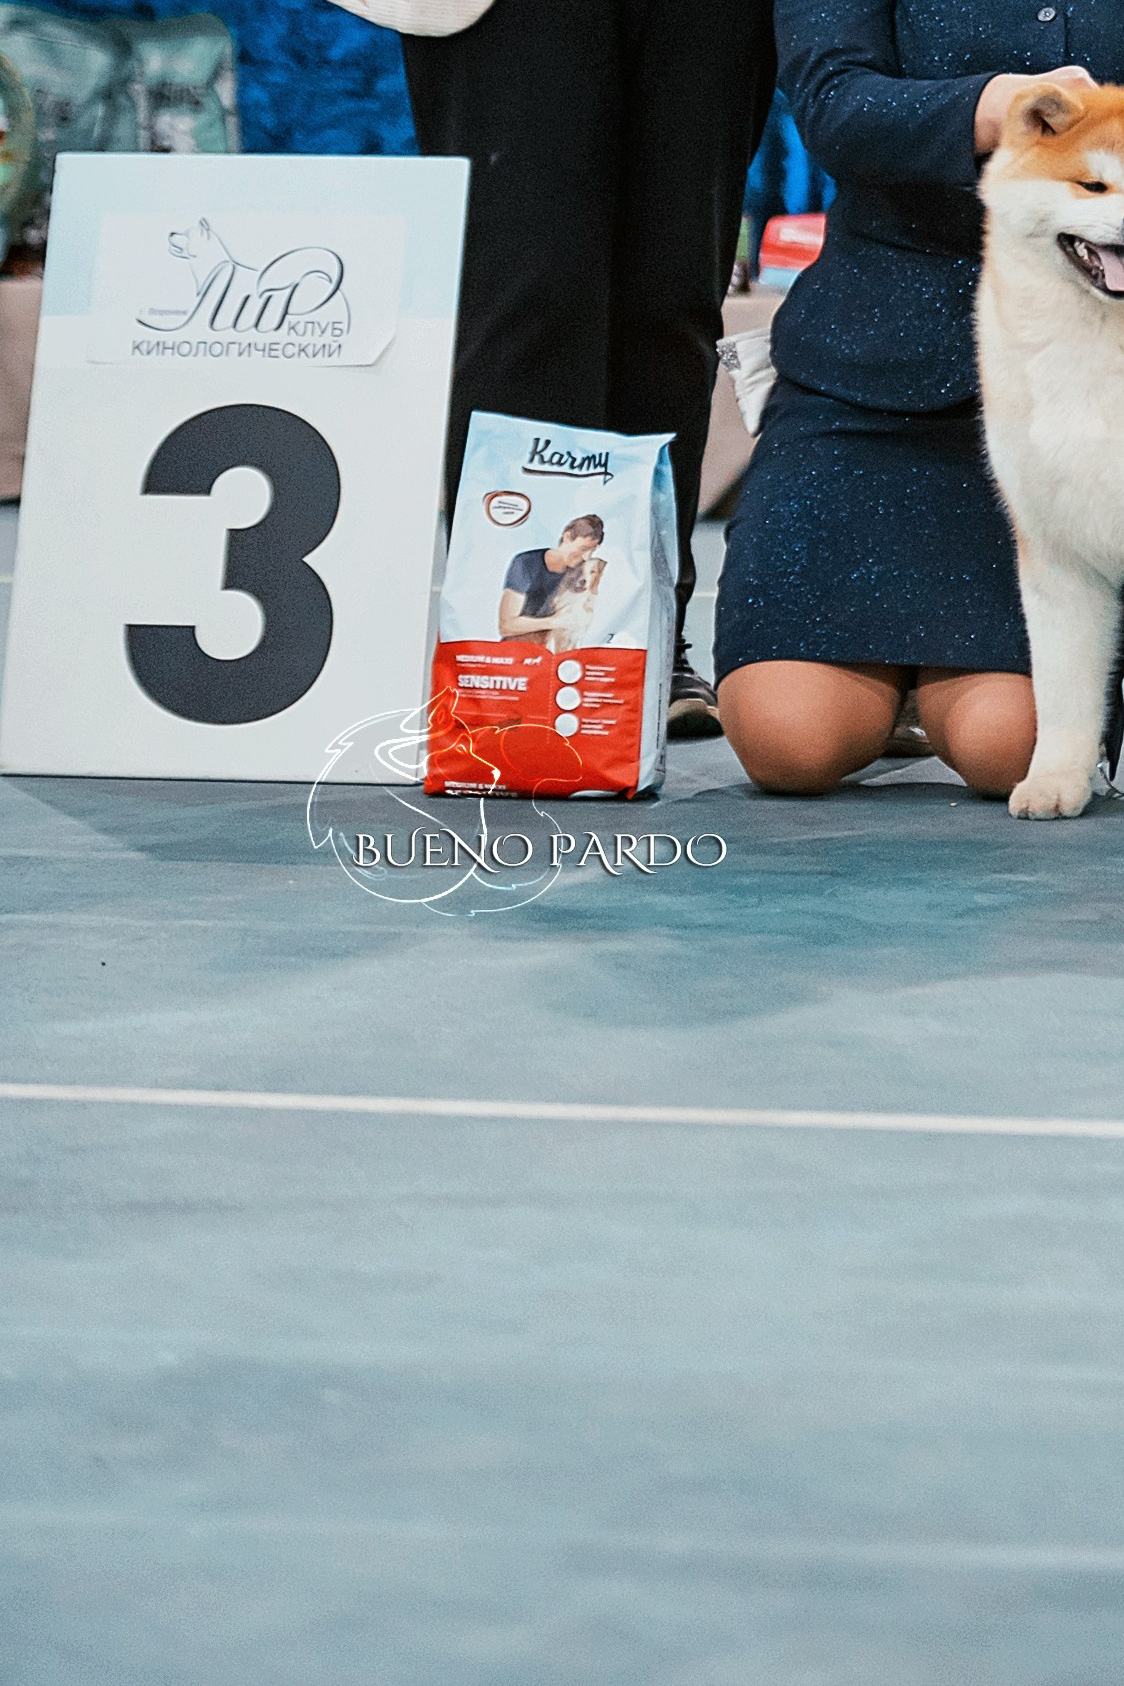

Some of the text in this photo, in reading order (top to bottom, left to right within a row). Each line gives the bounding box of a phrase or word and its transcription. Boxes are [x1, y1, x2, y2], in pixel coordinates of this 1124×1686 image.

[286, 320, 344, 338] КЛУБ
[131, 338, 343, 360] КИНОЛОГИЧЕСКИЙ
[524, 437, 613, 485] Karmy
[125, 403, 341, 726] 3
[458, 675, 528, 692] SENSITIVE
